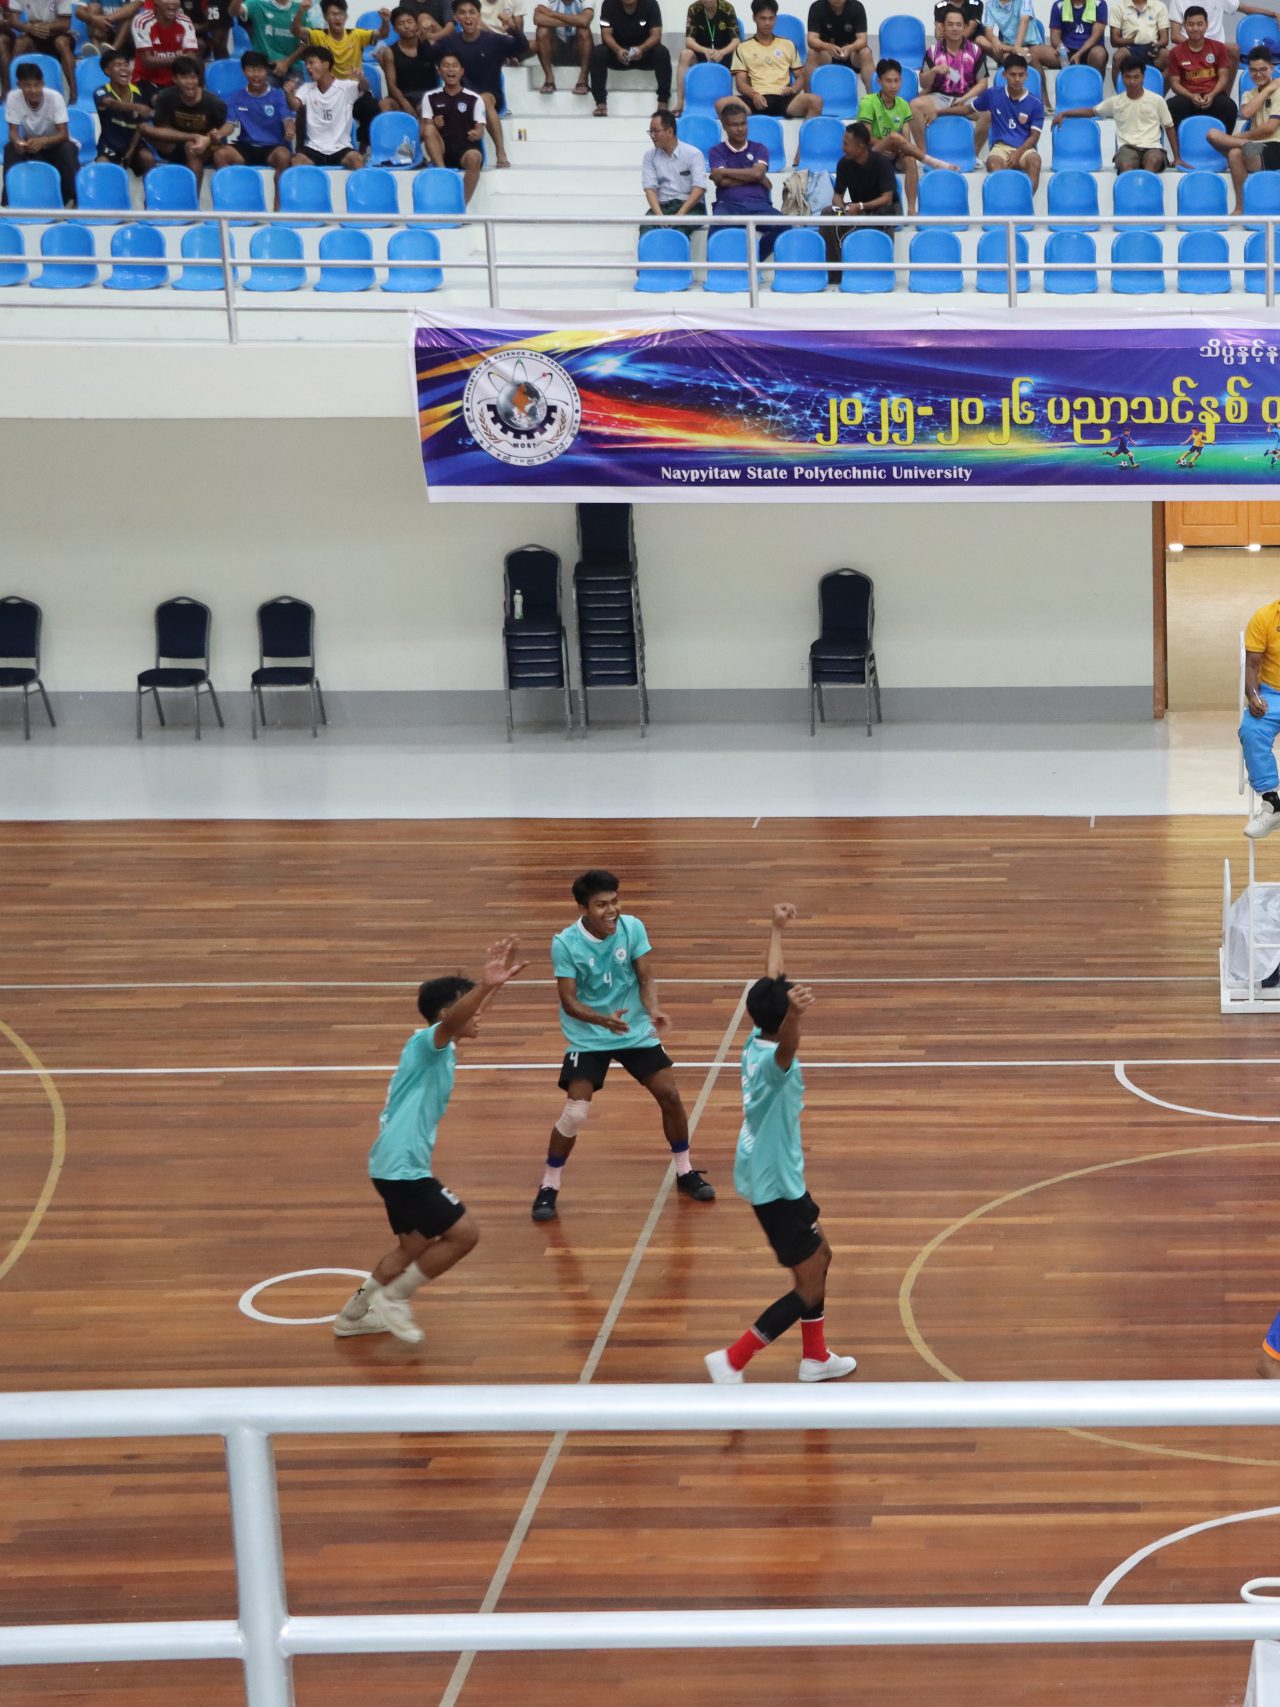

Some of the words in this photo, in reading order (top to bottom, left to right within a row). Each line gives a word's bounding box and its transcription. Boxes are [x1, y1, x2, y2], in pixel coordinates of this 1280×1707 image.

[661, 466, 742, 482] Naypyitaw
[746, 466, 788, 480] State
[794, 466, 887, 481] Polytechnic
[892, 466, 973, 481] University
[603, 971, 613, 988] 4
[569, 1051, 580, 1068] 4
